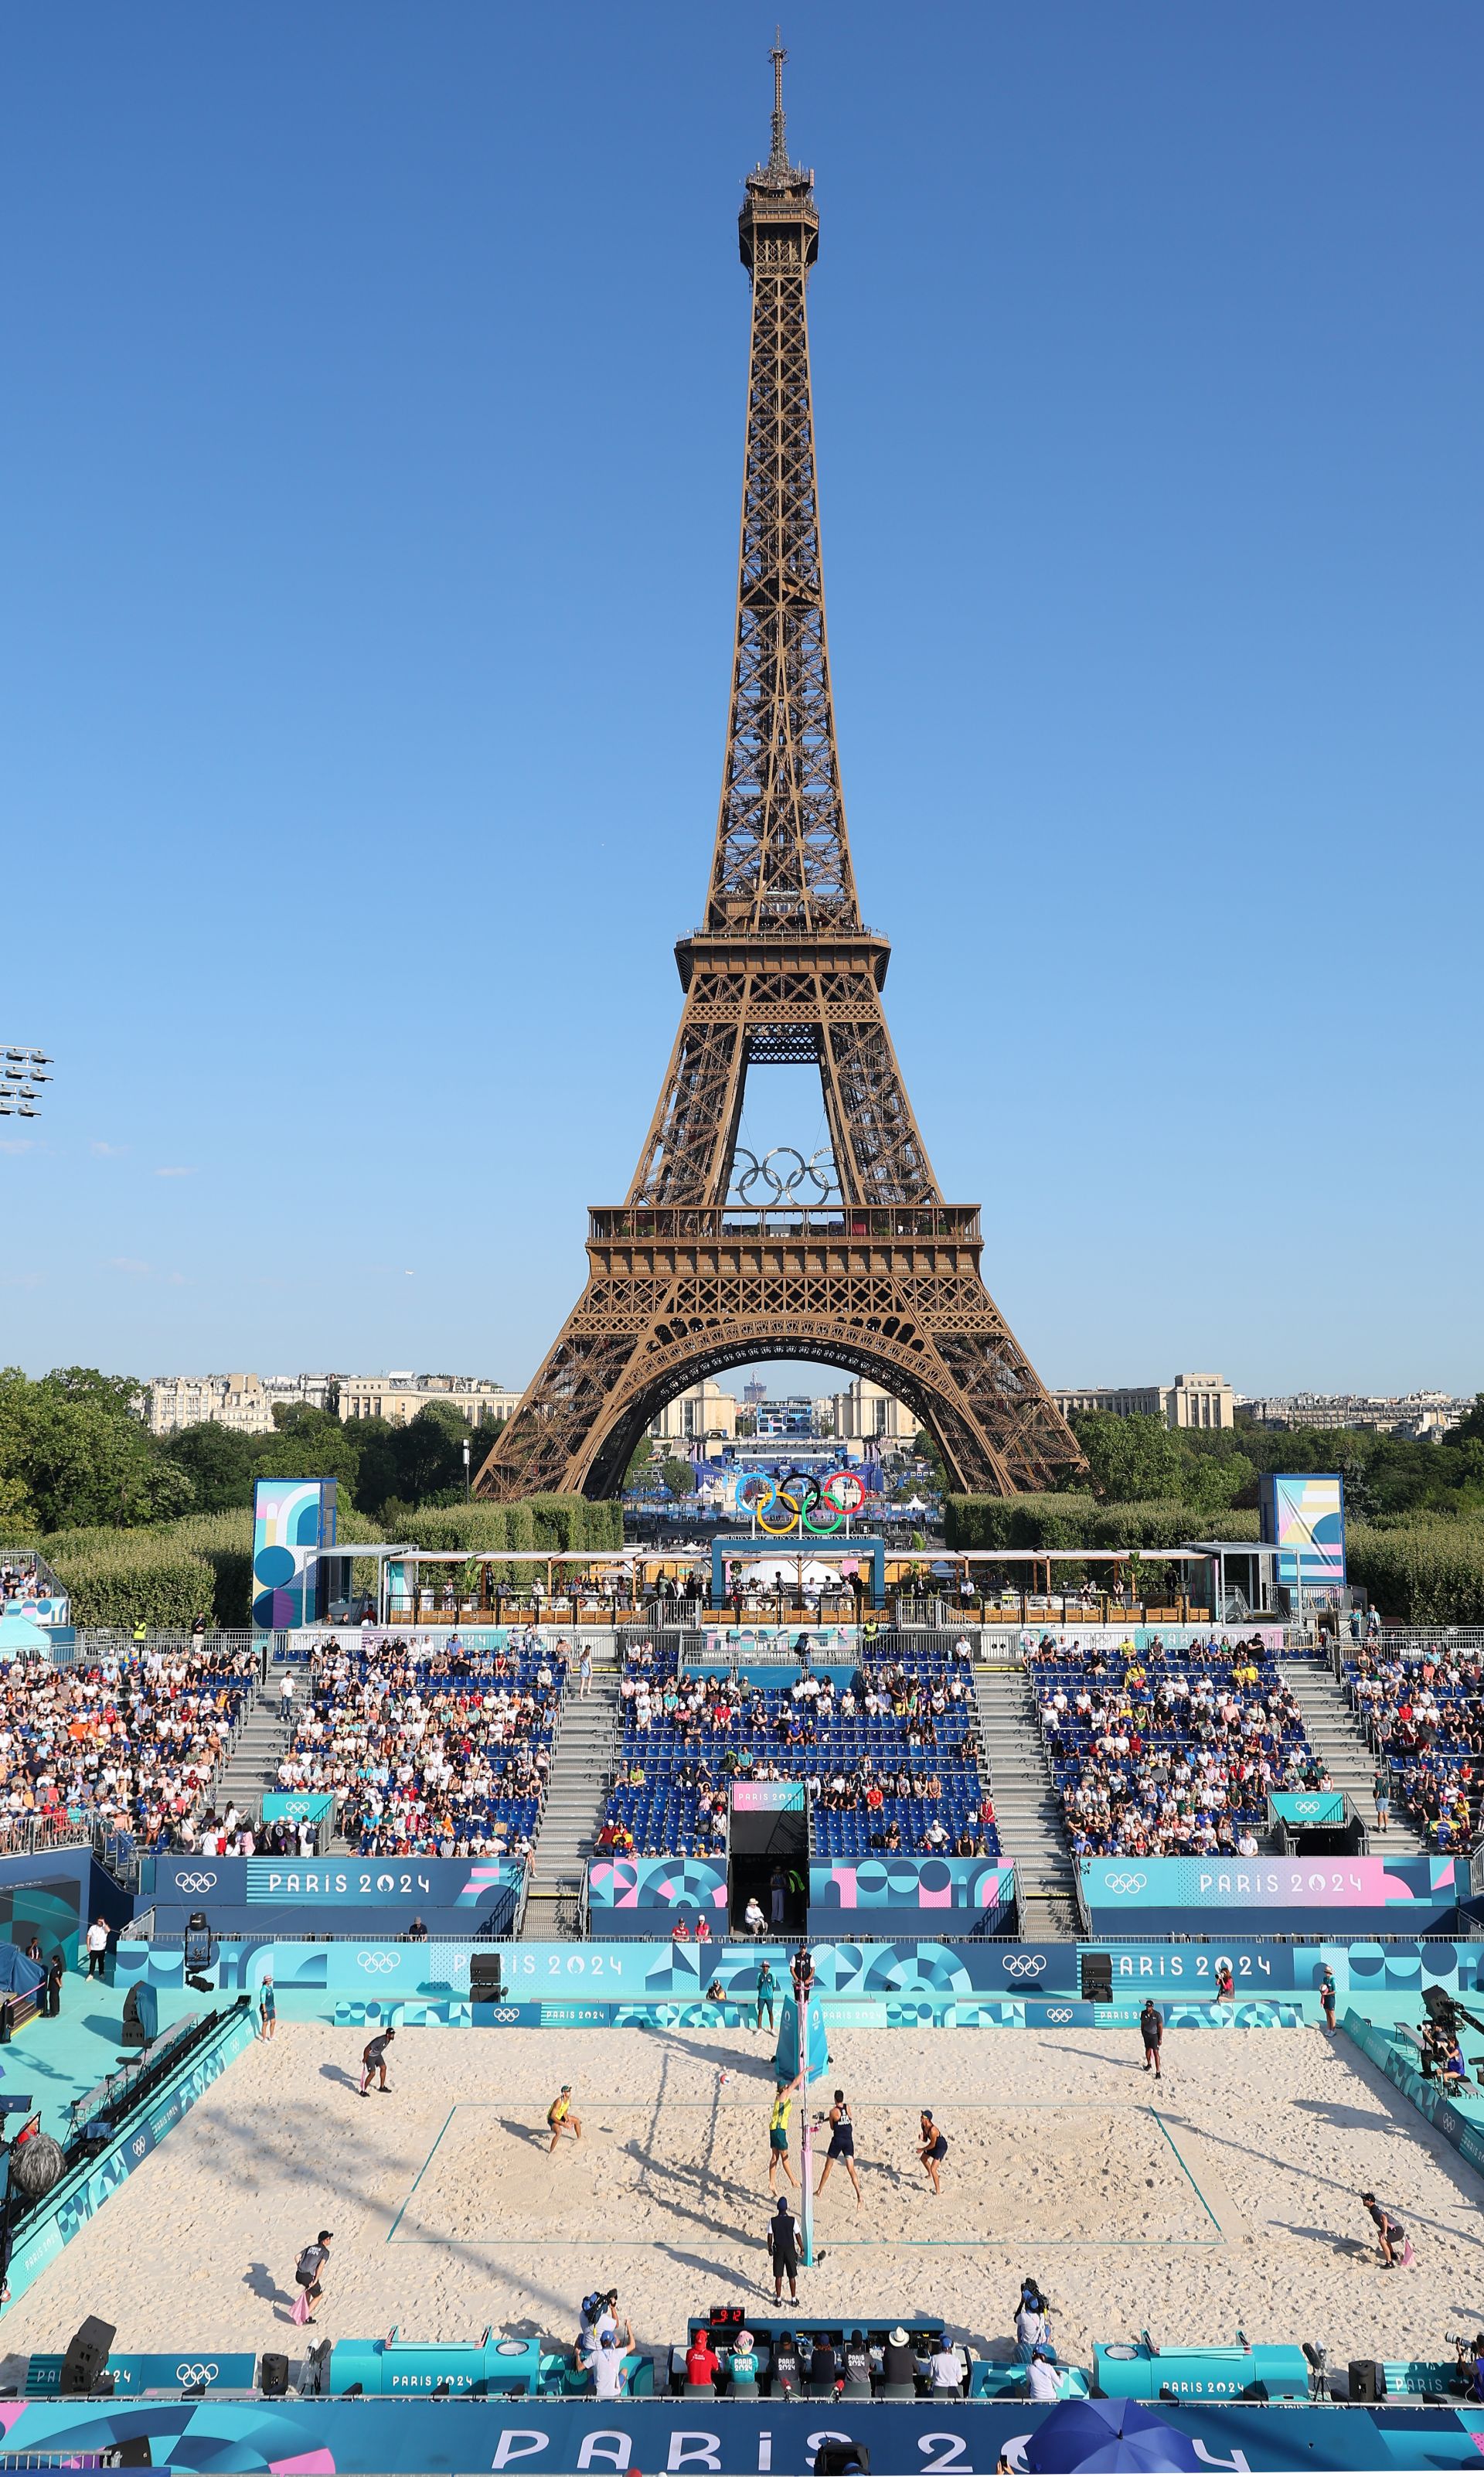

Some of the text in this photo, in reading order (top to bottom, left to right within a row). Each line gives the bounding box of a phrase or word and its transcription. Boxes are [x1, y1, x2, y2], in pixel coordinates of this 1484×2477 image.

[441, 1634, 486, 1646] 224
[359, 1874, 429, 1893] 2024
[1291, 1873, 1362, 1892] 2024
[548, 1955, 622, 1975] 2024
[1196, 1955, 1271, 1975] 2024
[578, 2011, 604, 2019] 2024
[437, 2375, 472, 2387] 2024
[1207, 2381, 1244, 2393] 2024
[917, 2432, 1252, 2474] 24
